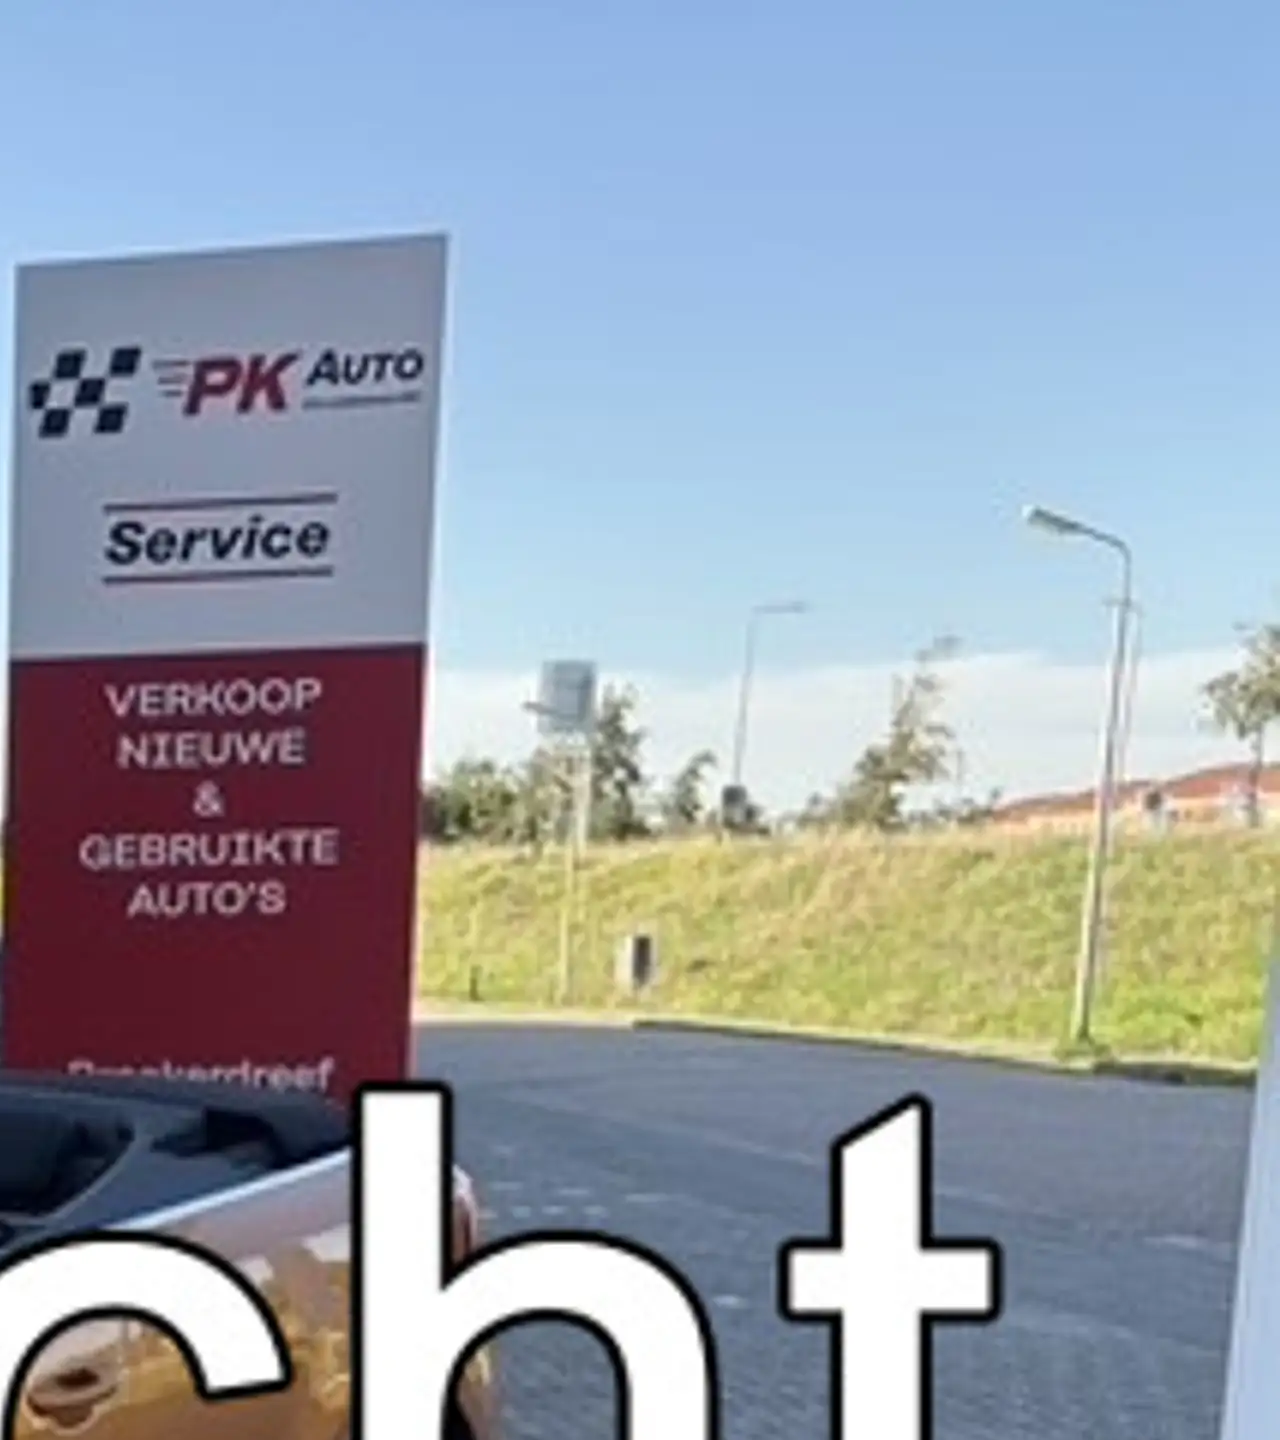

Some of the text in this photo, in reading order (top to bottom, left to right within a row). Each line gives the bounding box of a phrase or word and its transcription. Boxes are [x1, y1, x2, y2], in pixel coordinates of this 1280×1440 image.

[183, 351, 303, 416] PK
[103, 515, 330, 568] Service
[103, 677, 322, 718] VERKOOP
[116, 729, 306, 769] NIEUWE
[192, 780, 225, 818] &
[77, 827, 340, 871] GEBRUIKTE
[126, 880, 286, 919] AUTO'S
